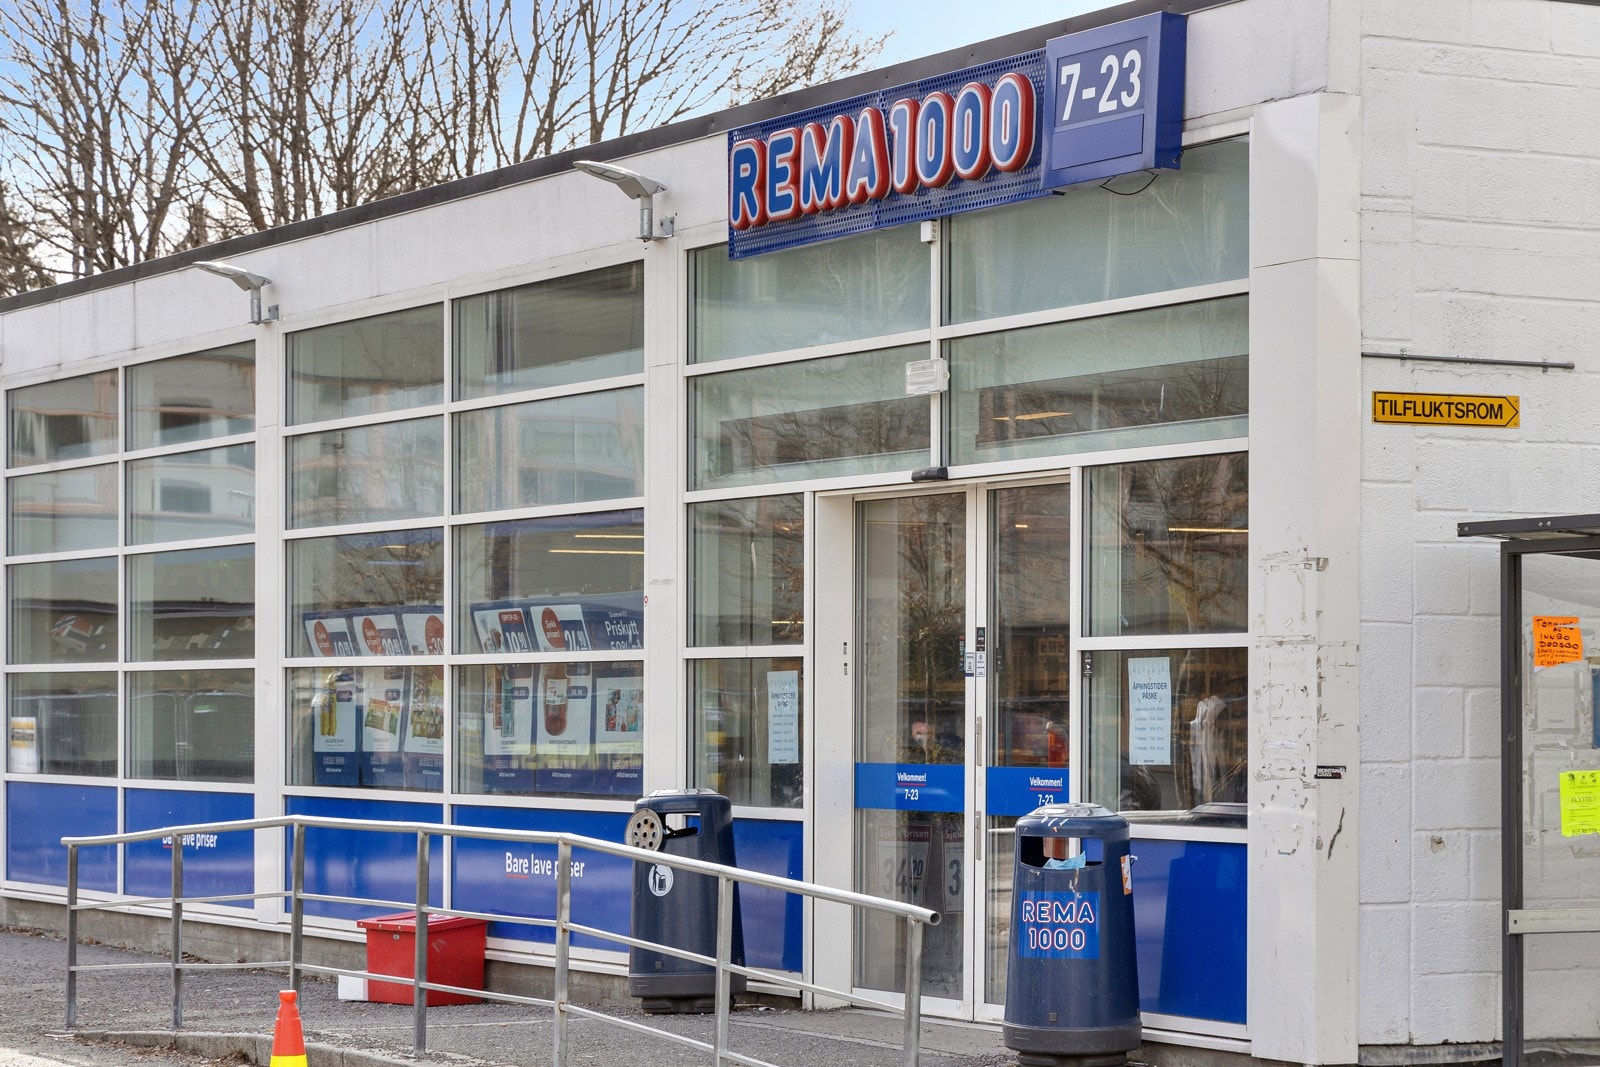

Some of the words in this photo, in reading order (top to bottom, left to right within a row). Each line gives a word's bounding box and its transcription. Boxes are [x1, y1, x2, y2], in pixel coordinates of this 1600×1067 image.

[1060, 49, 1142, 122] 7-23
[731, 107, 892, 231] REMA
[891, 73, 1036, 195] 1000
[1378, 399, 1504, 420] TILFLUKTSROM
[1133, 681, 1168, 690] ÅPNINGSTIDER
[1142, 691, 1158, 700] PÅSKE
[896, 772, 927, 783] Velkommen!
[1029, 776, 1063, 787] Velkommen!
[904, 788, 919, 801] 7-23
[1037, 794, 1054, 806] 7-23
[182, 834, 195, 846] ave
[945, 830, 964, 840] Sjek
[505, 851, 529, 874] Bare
[531, 853, 552, 876] lave
[1022, 900, 1095, 924] REMA
[1028, 928, 1086, 950] 1000
